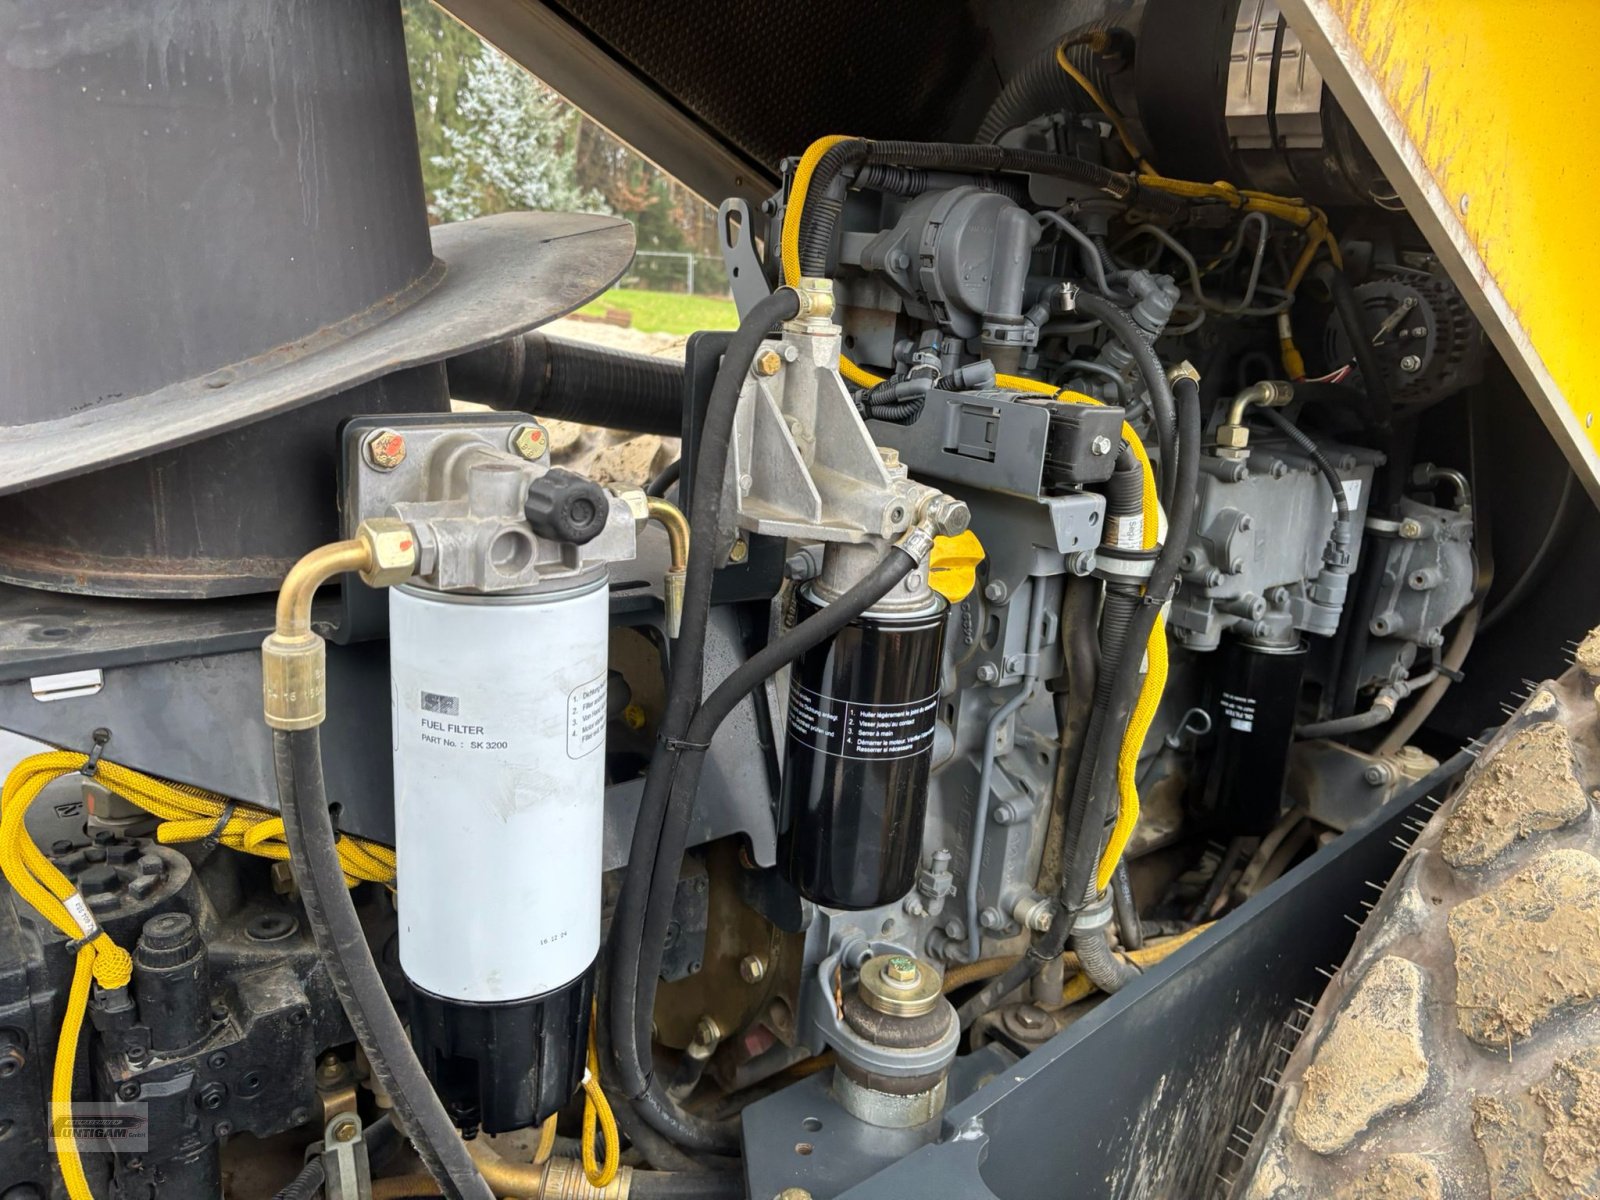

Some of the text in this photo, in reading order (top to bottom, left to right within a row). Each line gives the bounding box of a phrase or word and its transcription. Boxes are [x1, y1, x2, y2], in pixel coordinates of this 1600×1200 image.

[421, 718, 484, 735] FUEL FILTER
[421, 733, 441, 745] PART
[443, 738, 457, 748] No.
[470, 741, 484, 750] SK
[485, 741, 508, 750] 3200
